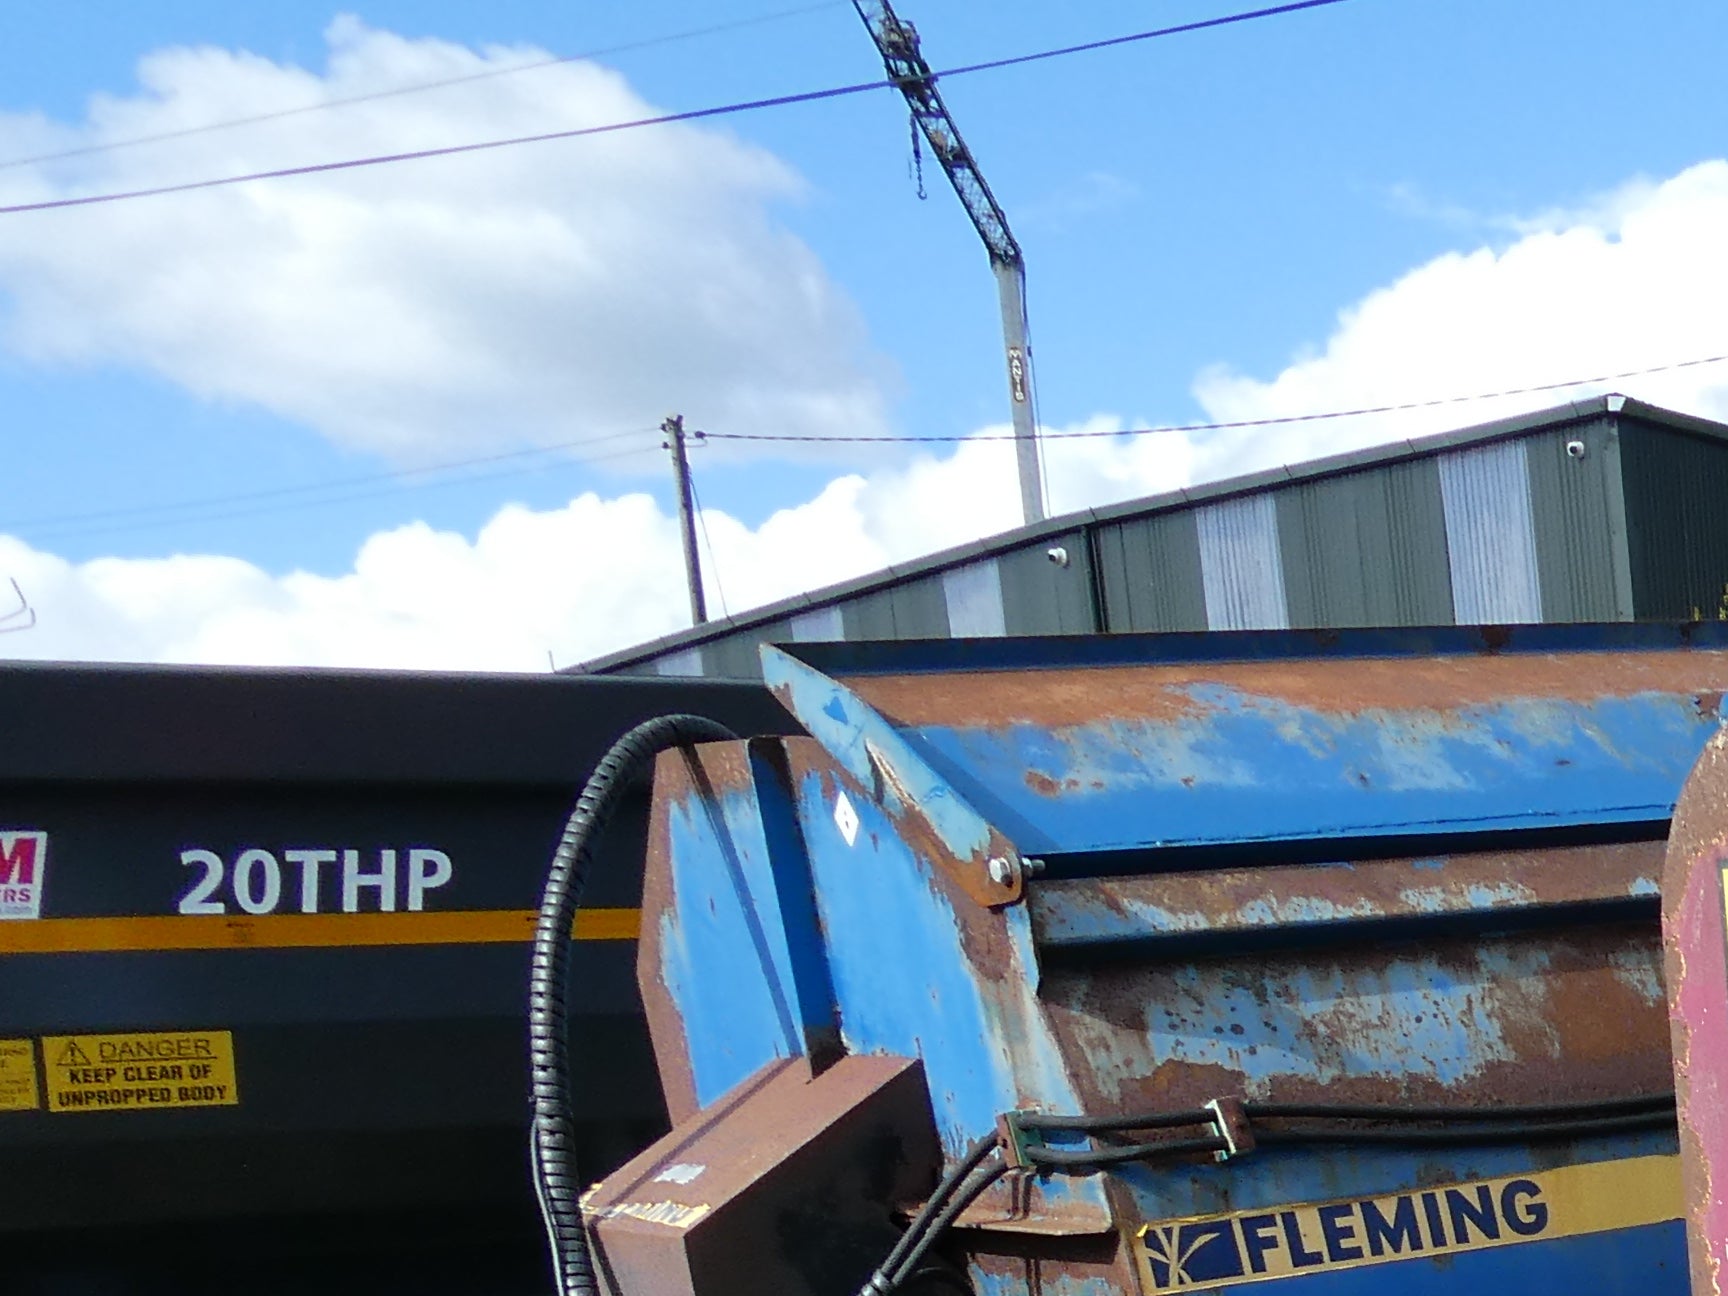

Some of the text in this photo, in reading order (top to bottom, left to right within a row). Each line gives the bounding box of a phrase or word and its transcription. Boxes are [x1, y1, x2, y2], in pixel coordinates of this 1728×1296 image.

[179, 849, 452, 914] 20THP
[100, 1039, 212, 1058] DANGER
[69, 1064, 212, 1084] KEEP CLEAR OF
[58, 1085, 227, 1107] UNPROPPED BODY
[1239, 1180, 1549, 1274] FLEMING
